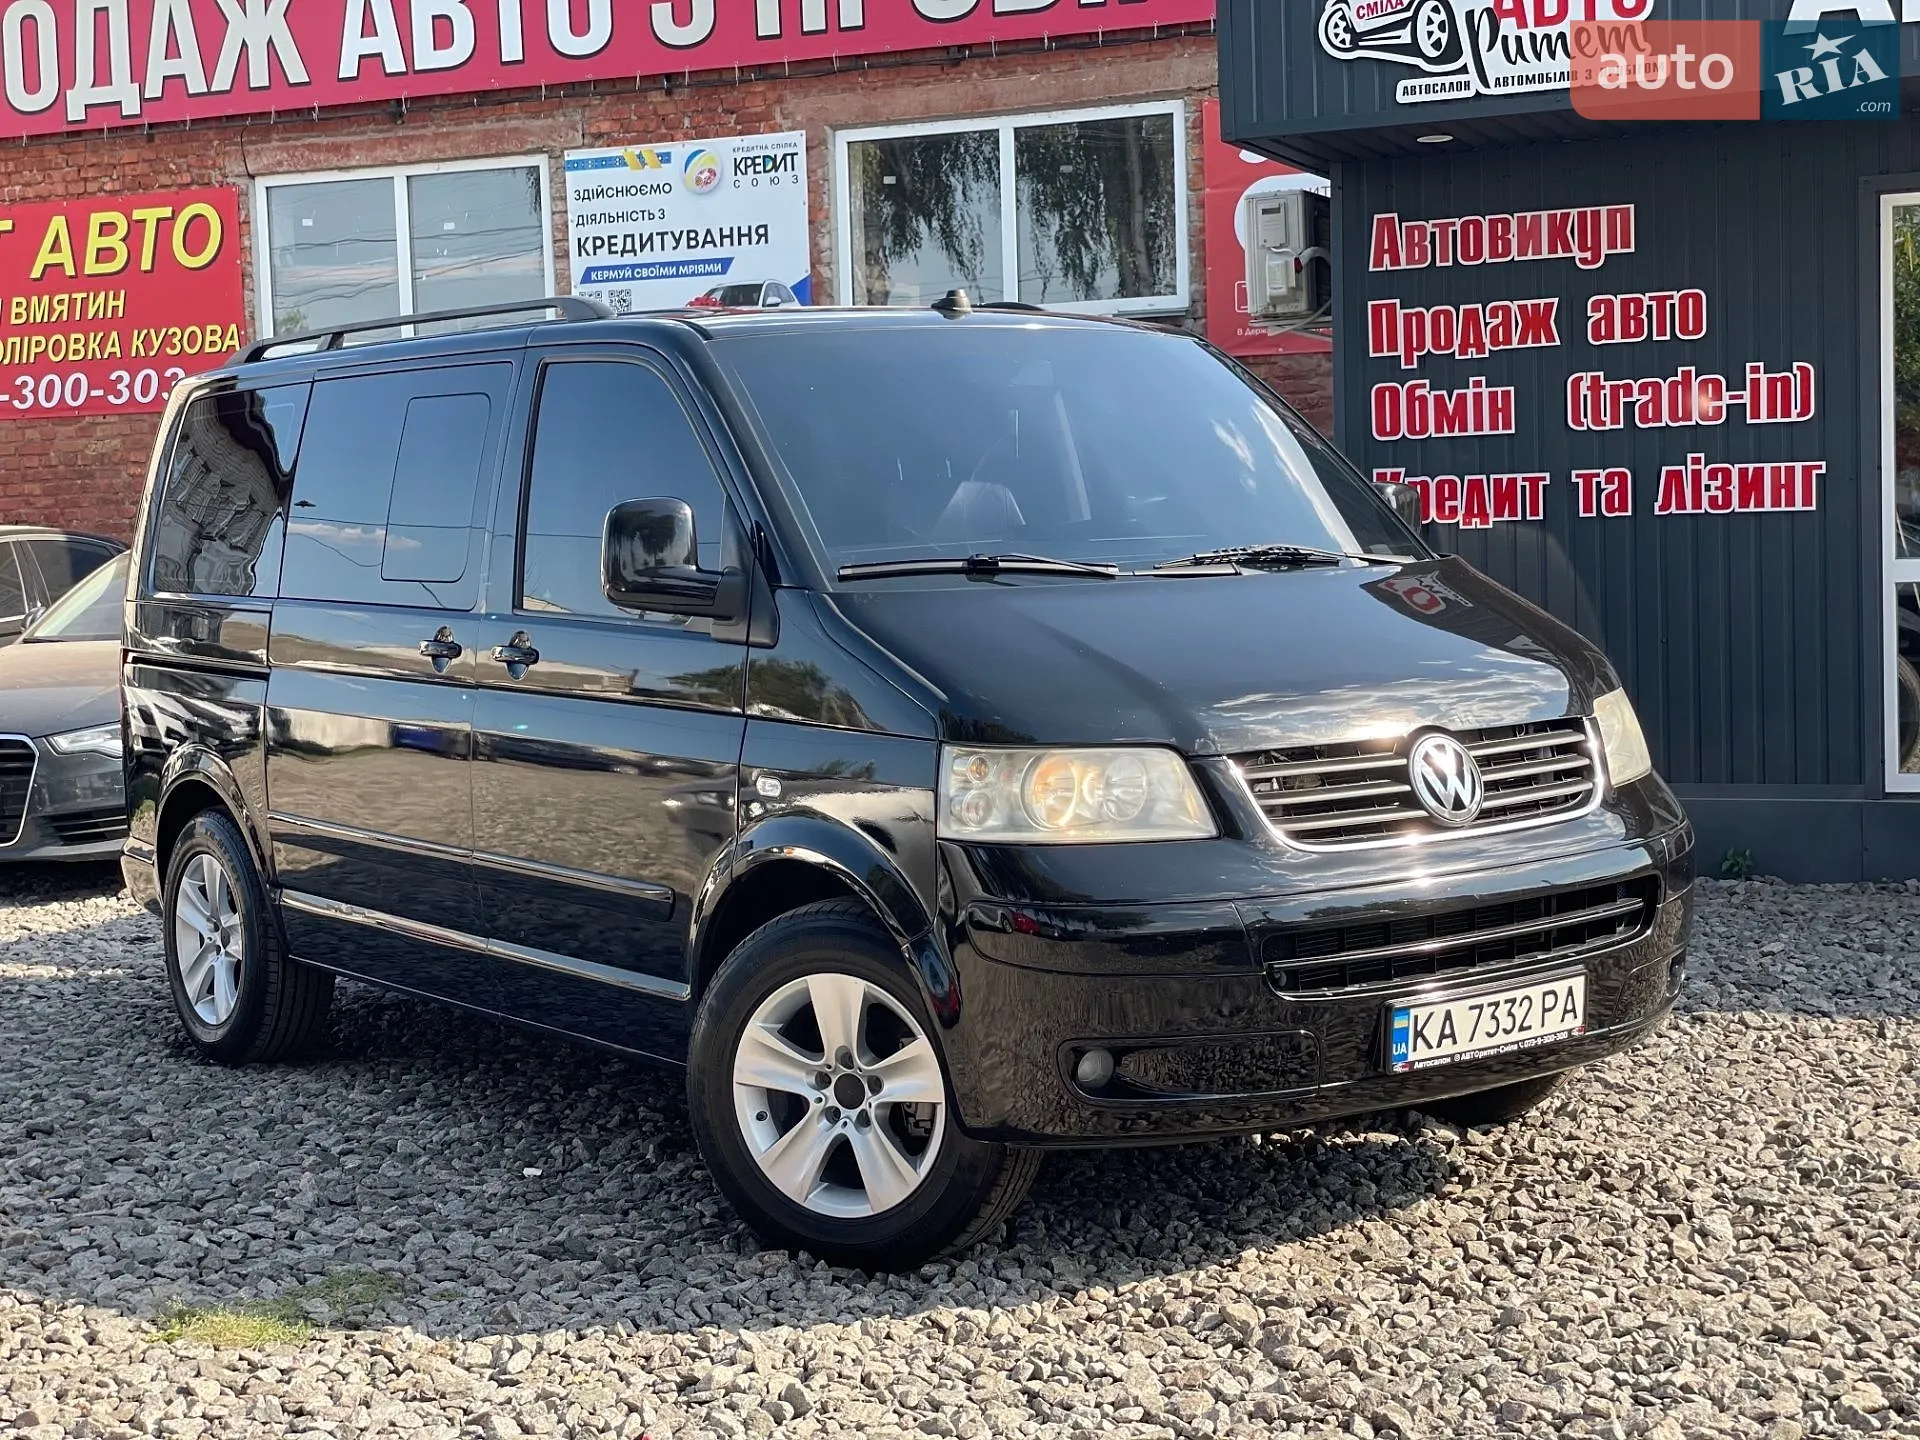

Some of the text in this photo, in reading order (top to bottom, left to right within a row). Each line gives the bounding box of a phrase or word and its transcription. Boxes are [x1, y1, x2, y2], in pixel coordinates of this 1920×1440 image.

[1401, 79, 1471, 97] АВТОСАЛОН
[1494, 69, 1578, 88] АВТОМОБІЛІВ
[574, 182, 673, 202] ЗДІЙСНЮЄМО
[575, 208, 666, 228] ДІЯЛЬНІСТЬ З
[29, 202, 223, 280] АВТО
[577, 223, 769, 258] КРЕДИТУВАННЯ
[1368, 203, 1635, 271] Автовикуп
[590, 262, 722, 282] КЕРМУЙ СВОЇМИ МРІЯМИ
[10, 290, 126, 325] ВМЯТИН
[0, 323, 241, 366] ЛІРОВКА КУЗОВА
[1367, 288, 1707, 369] Продаж авто
[1371, 361, 1815, 441] Обмін (trade-in)
[1571, 467, 1632, 517] та
[1654, 453, 1826, 516] лізинг
[1411, 985, 1578, 1053] KA 7332 PA
[1393, 1041, 1407, 1056] UA
